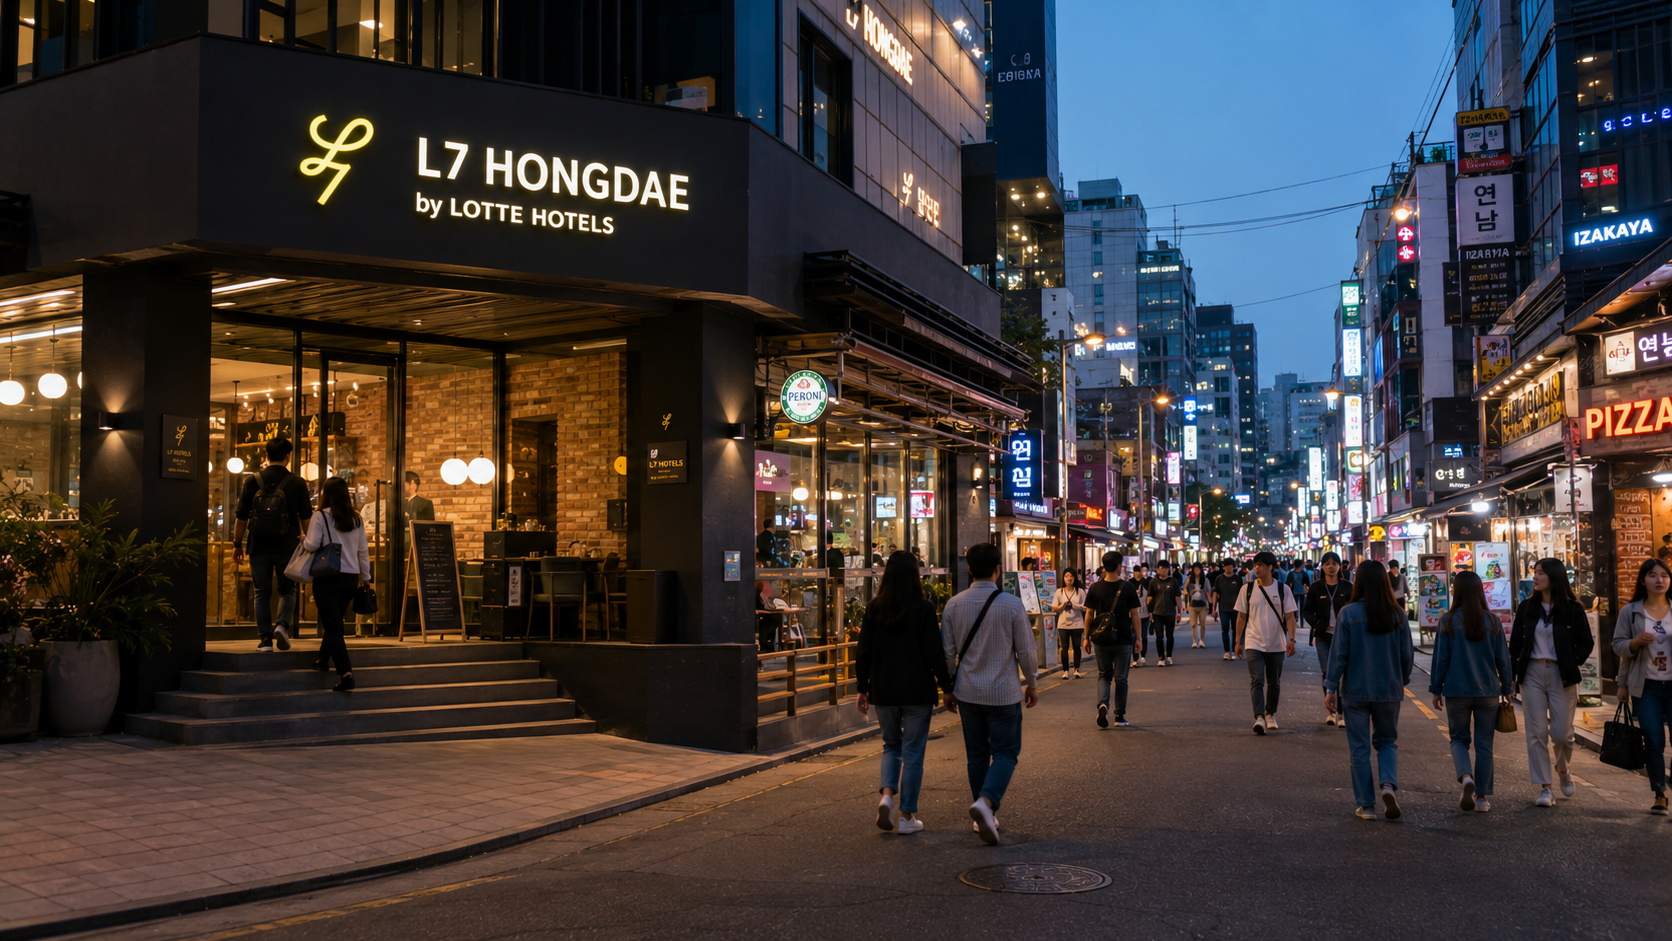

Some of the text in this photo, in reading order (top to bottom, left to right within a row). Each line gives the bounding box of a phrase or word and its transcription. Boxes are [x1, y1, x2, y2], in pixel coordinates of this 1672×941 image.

[863, 3, 913, 86] HONGDAE
[417, 136, 691, 211] L7 HONGDAE
[416, 192, 615, 235] by LOTTE HOTELS
[1474, 183, 1499, 233] 연남
[1574, 218, 1654, 246] IZAKAYA
[788, 391, 822, 402] PERONI
[1585, 396, 1672, 440] PIZZA
[649, 459, 684, 469] L7 HOTELS
